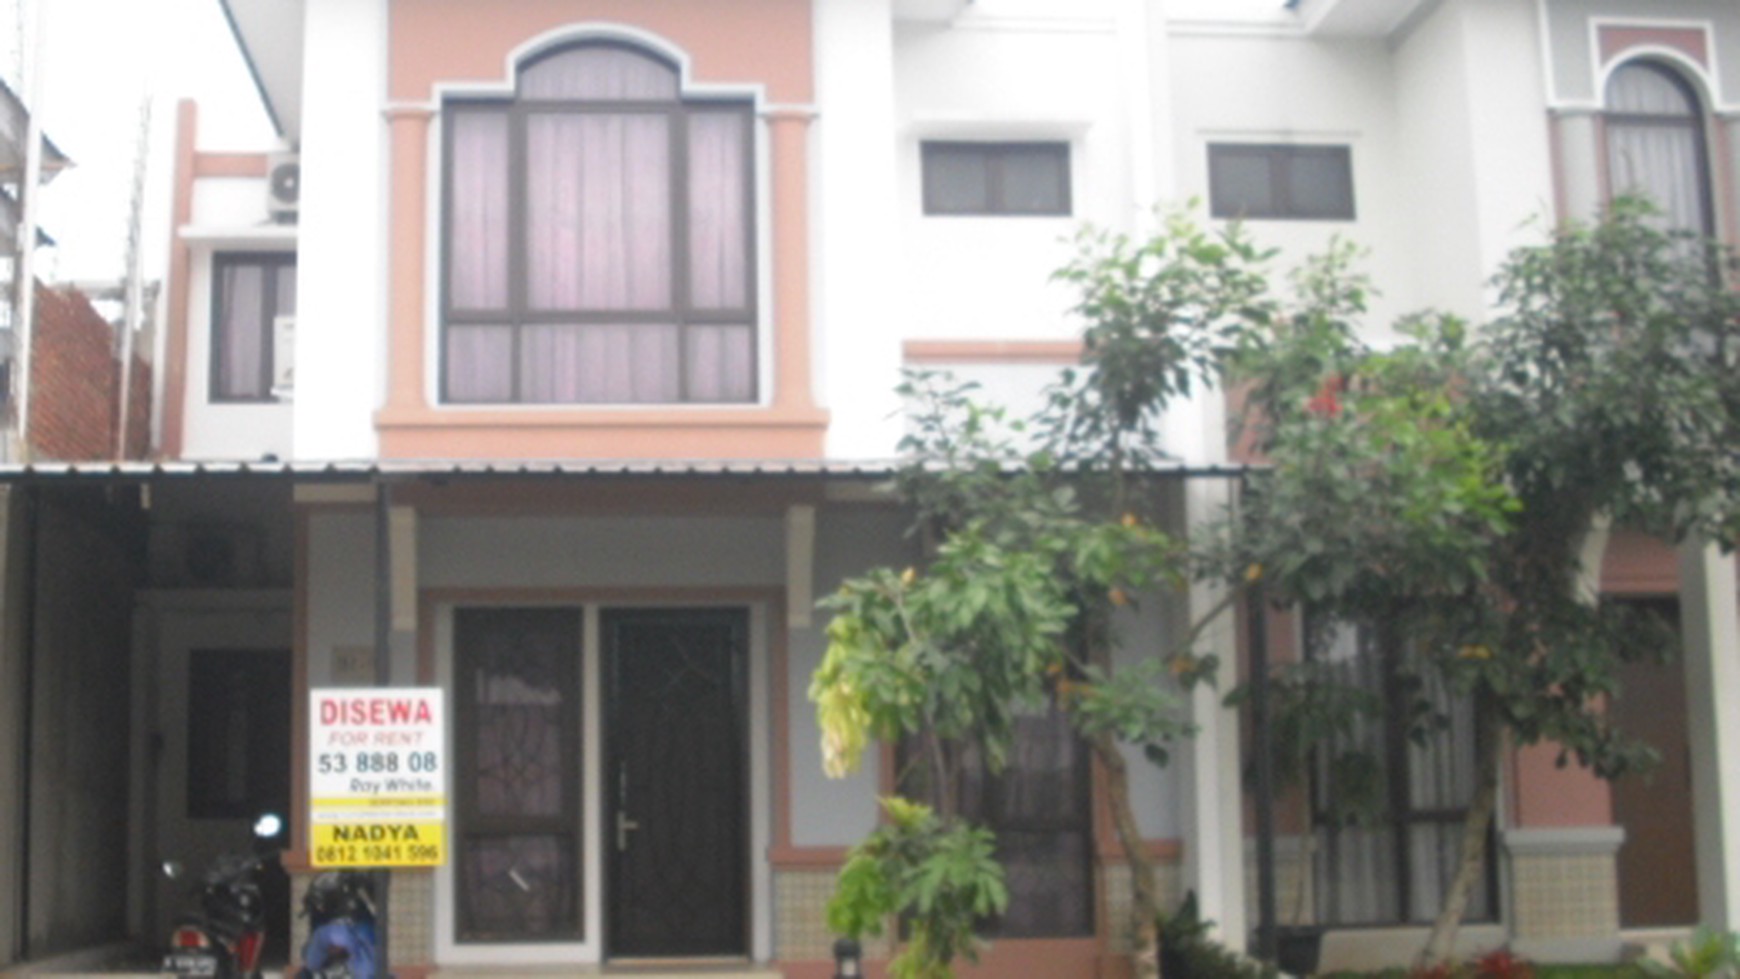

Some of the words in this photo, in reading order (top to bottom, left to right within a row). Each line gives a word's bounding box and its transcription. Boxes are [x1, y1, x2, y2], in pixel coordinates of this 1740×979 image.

[320, 699, 432, 726] DISEWA
[328, 732, 368, 747] FOR
[373, 732, 424, 746] RENT
[319, 753, 348, 774] 53
[356, 752, 399, 773] 888
[408, 751, 438, 773] 08
[333, 824, 420, 842] NADYA
[316, 845, 356, 862] 0812
